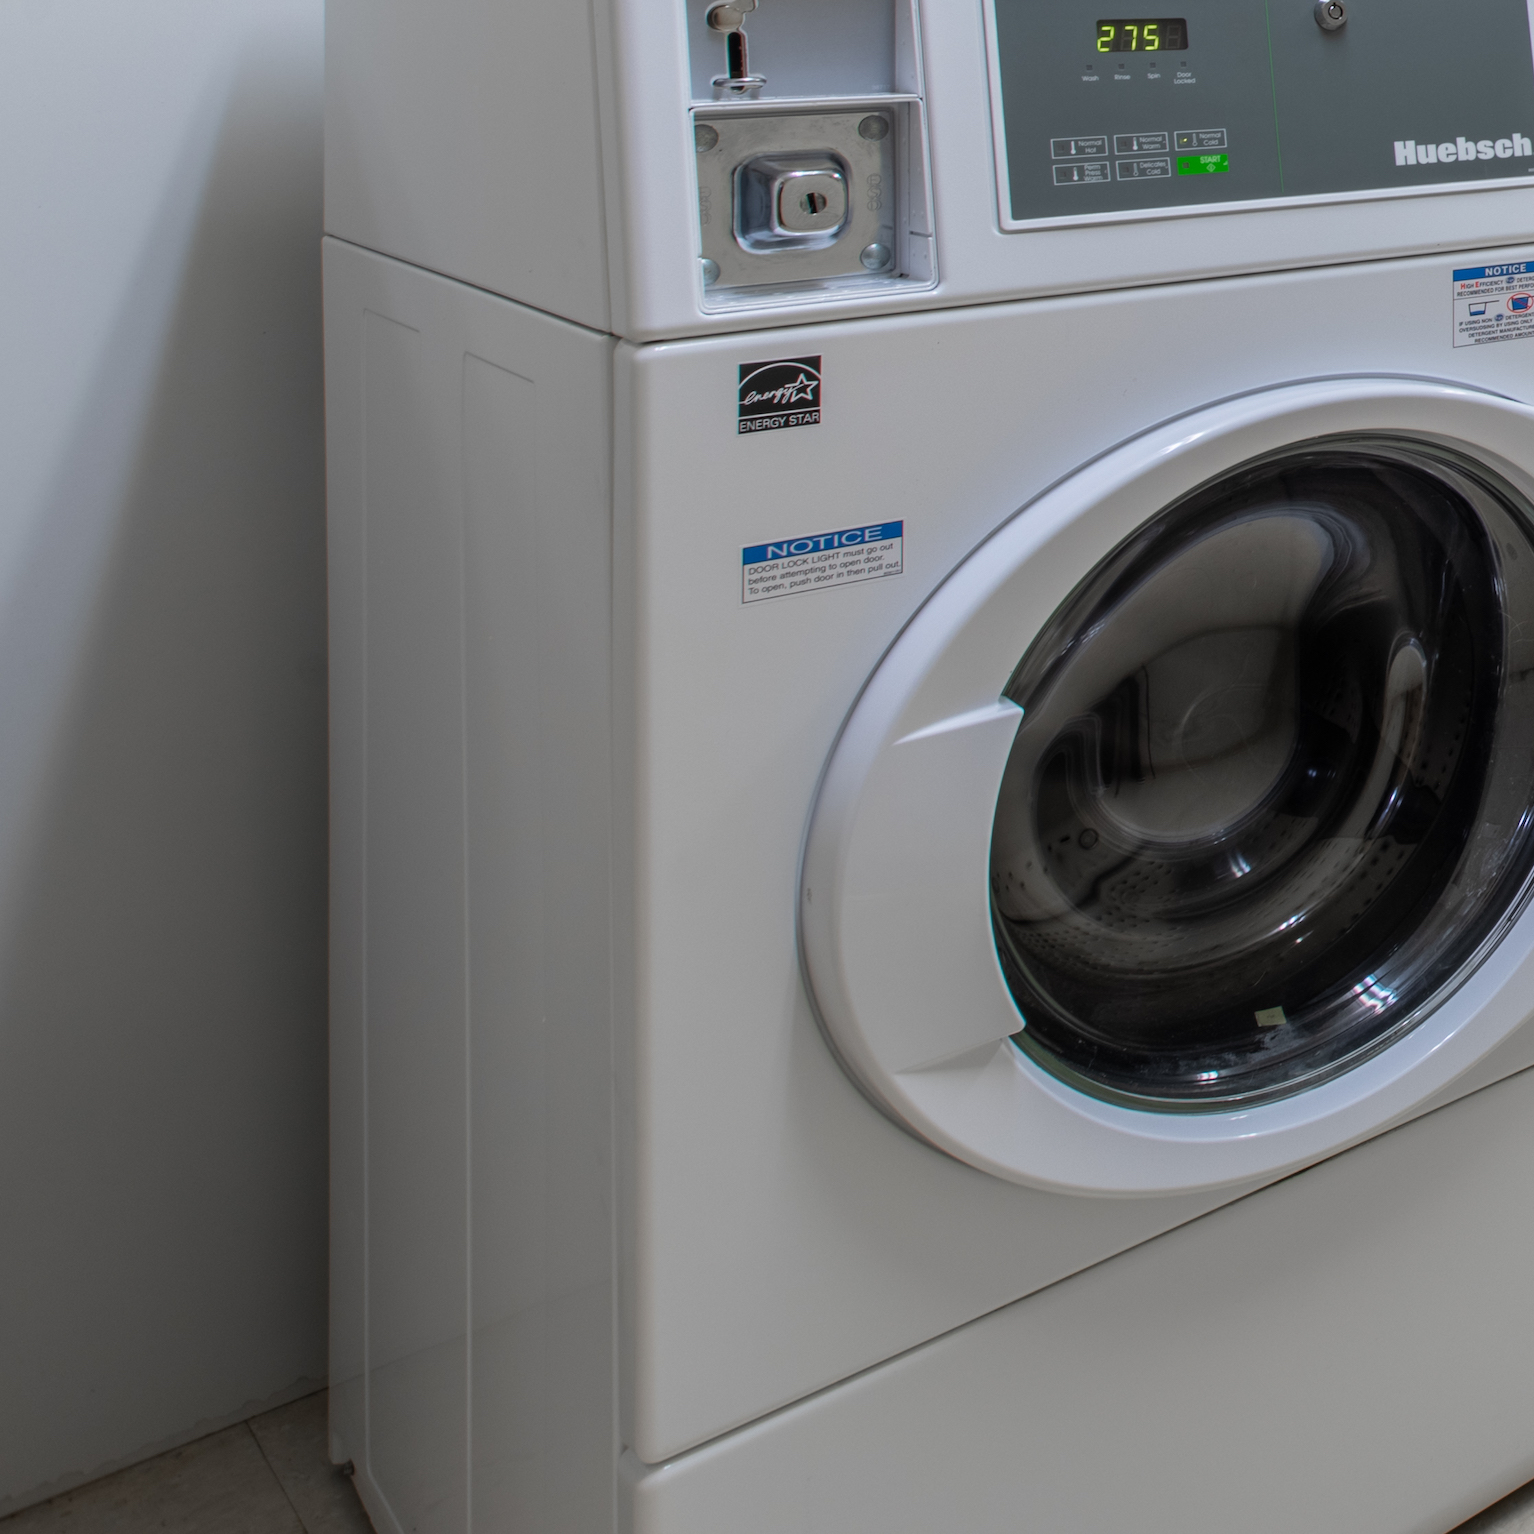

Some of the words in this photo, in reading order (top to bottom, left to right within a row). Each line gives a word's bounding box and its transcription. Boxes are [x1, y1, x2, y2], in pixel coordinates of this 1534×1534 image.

[1096, 25, 1159, 52] 275
[1200, 155, 1221, 164] START
[1394, 133, 1532, 166] Huebsch
[1485, 263, 1526, 276] NOTICE
[740, 416, 786, 432] ENERGY
[789, 412, 819, 425] STAR
[766, 526, 882, 559] NOTICE
[748, 575, 777, 586] before
[780, 566, 826, 580] attempting
[839, 559, 861, 569] open
[864, 554, 884, 564] door.
[749, 564, 779, 576] DOOR
[782, 558, 809, 569] LOCK
[812, 552, 840, 564] LIGHT
[843, 548, 864, 558] must
[867, 547, 878, 556] go
[748, 587, 759, 595] To
[762, 582, 787, 593] open,
[790, 578, 812, 588] push
[814, 573, 834, 582] door
[846, 566, 866, 576] then
[868, 561, 883, 573] pull
[885, 560, 900, 570] out.
